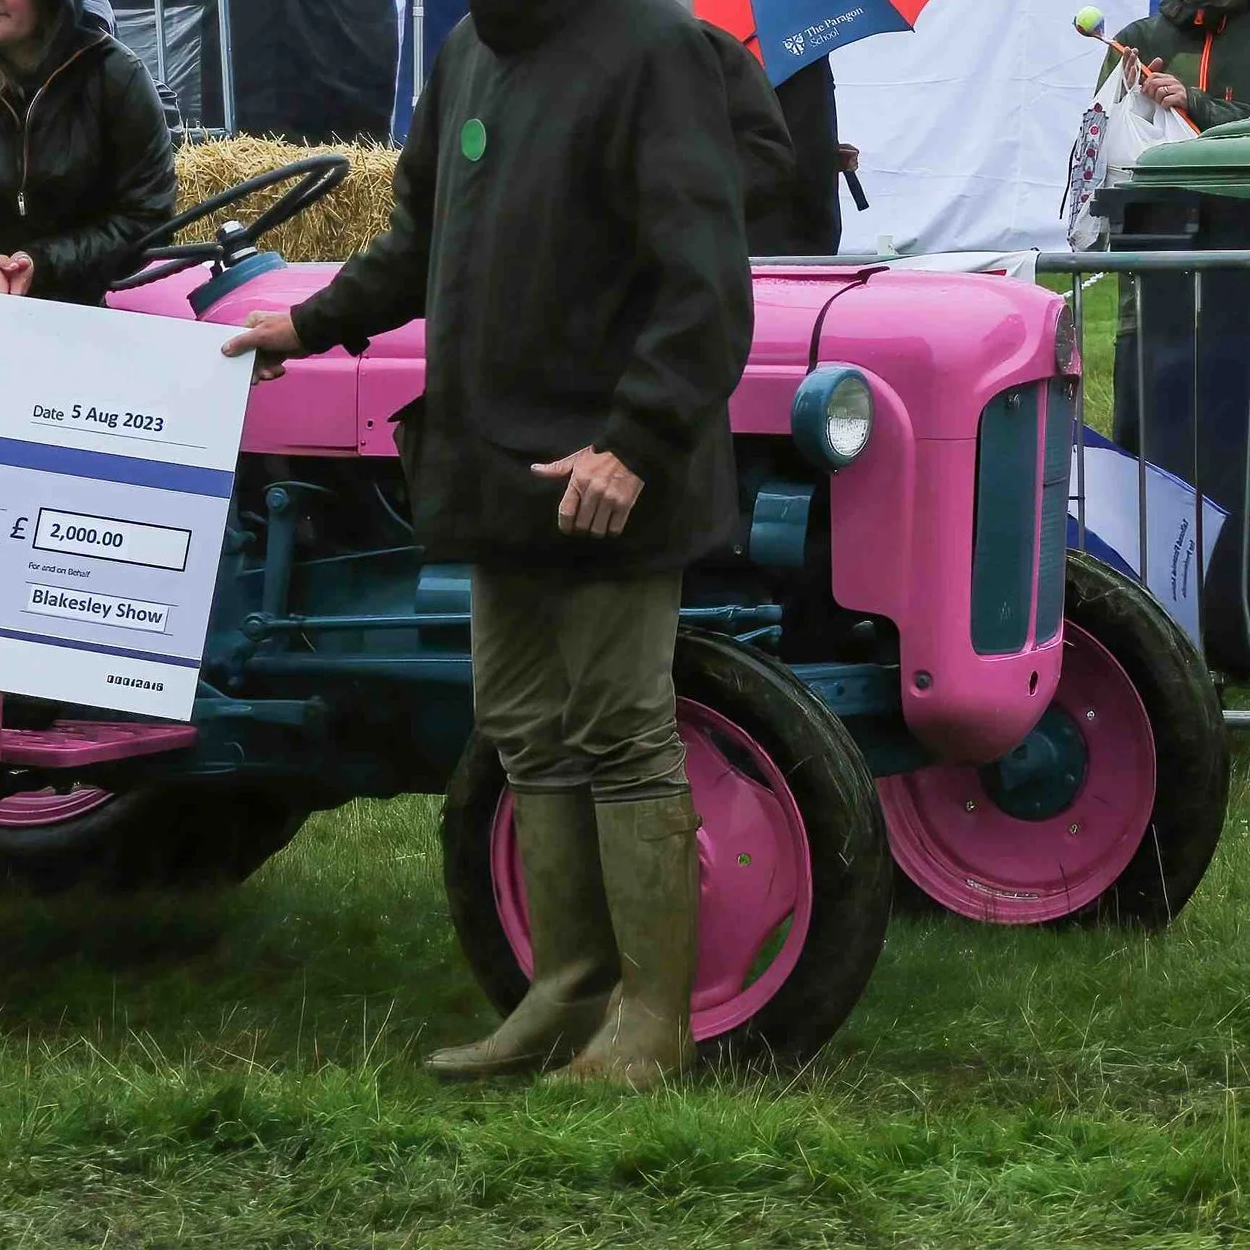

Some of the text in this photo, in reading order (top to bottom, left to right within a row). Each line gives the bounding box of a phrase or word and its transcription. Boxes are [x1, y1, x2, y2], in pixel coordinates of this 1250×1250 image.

[805, 6, 864, 37] The Paragon
[810, 27, 840, 48] School
[34, 405, 163, 431] Date 5 Aug 2023
[10, 517, 123, 547] £ 2,000.00
[28, 561, 41, 570] For
[68, 568, 91, 578] Behalf
[33, 589, 163, 623] Blakesley Show
